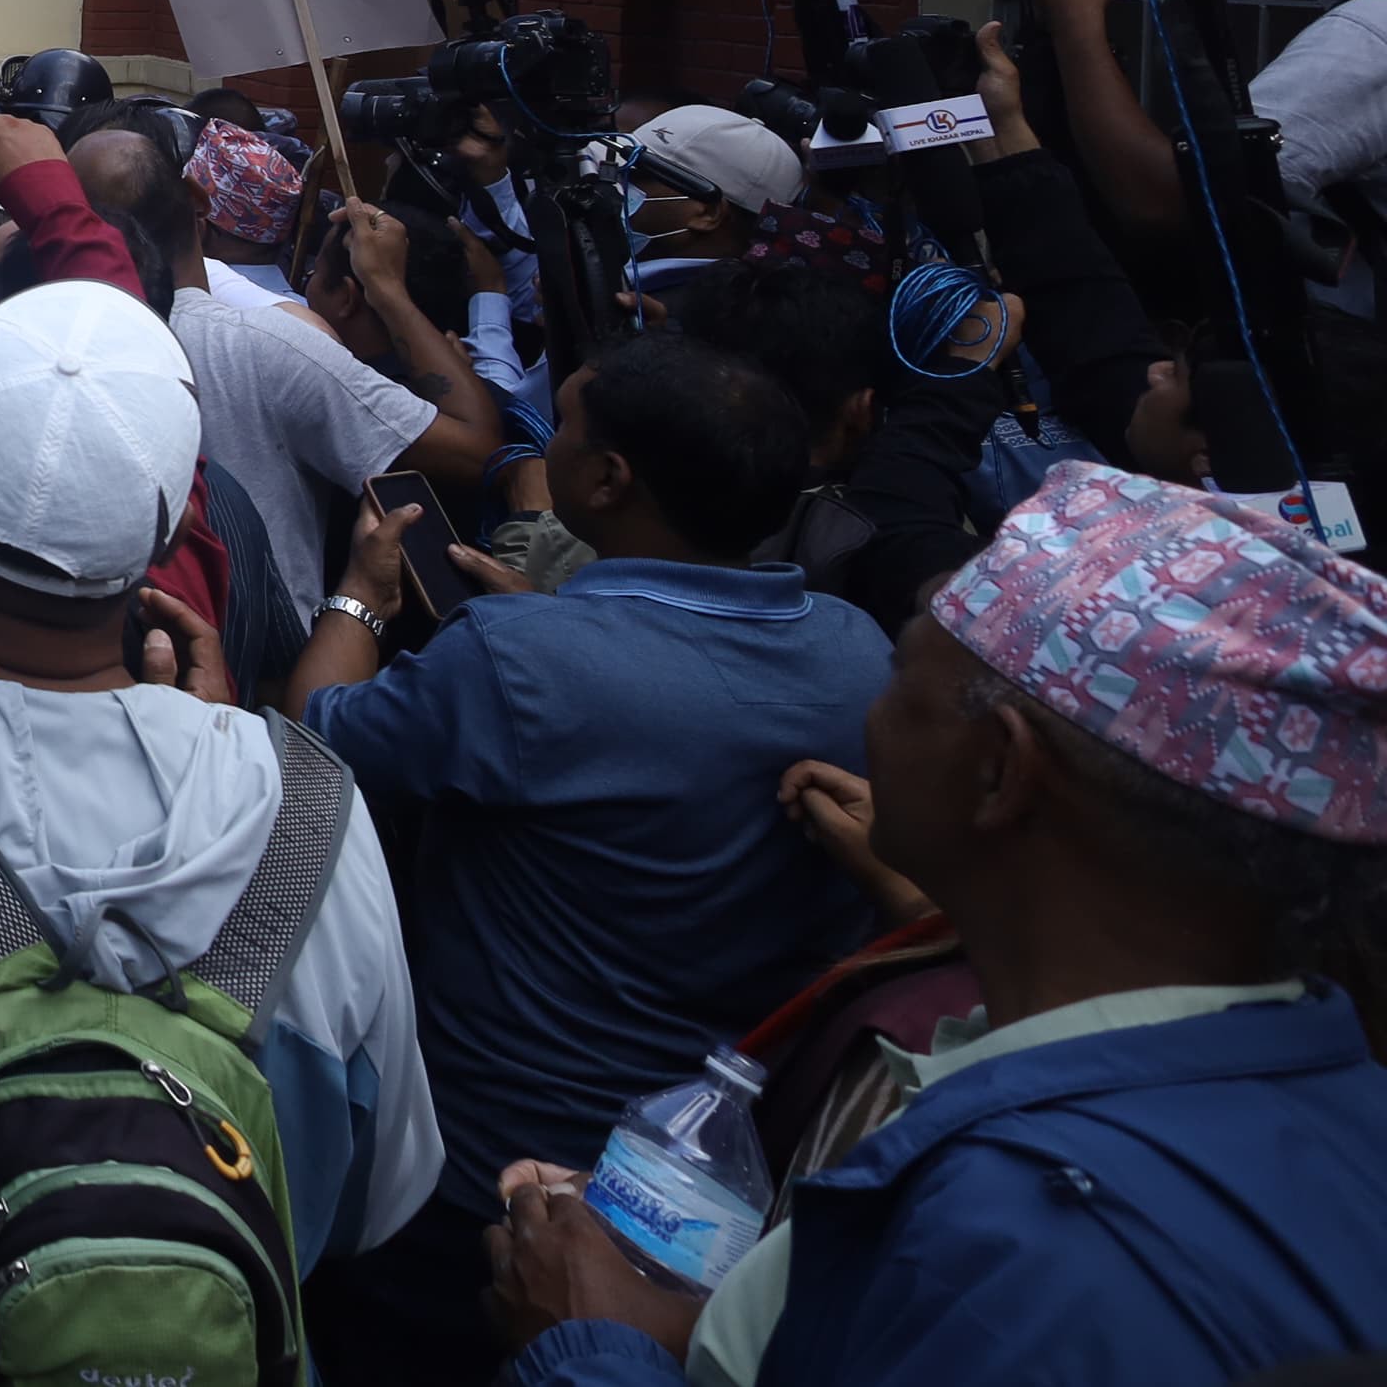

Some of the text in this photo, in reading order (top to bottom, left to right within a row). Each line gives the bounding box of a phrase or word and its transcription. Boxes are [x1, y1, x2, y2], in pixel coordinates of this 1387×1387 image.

[909, 128, 986, 147] LIVE KHABAR NEPAL
